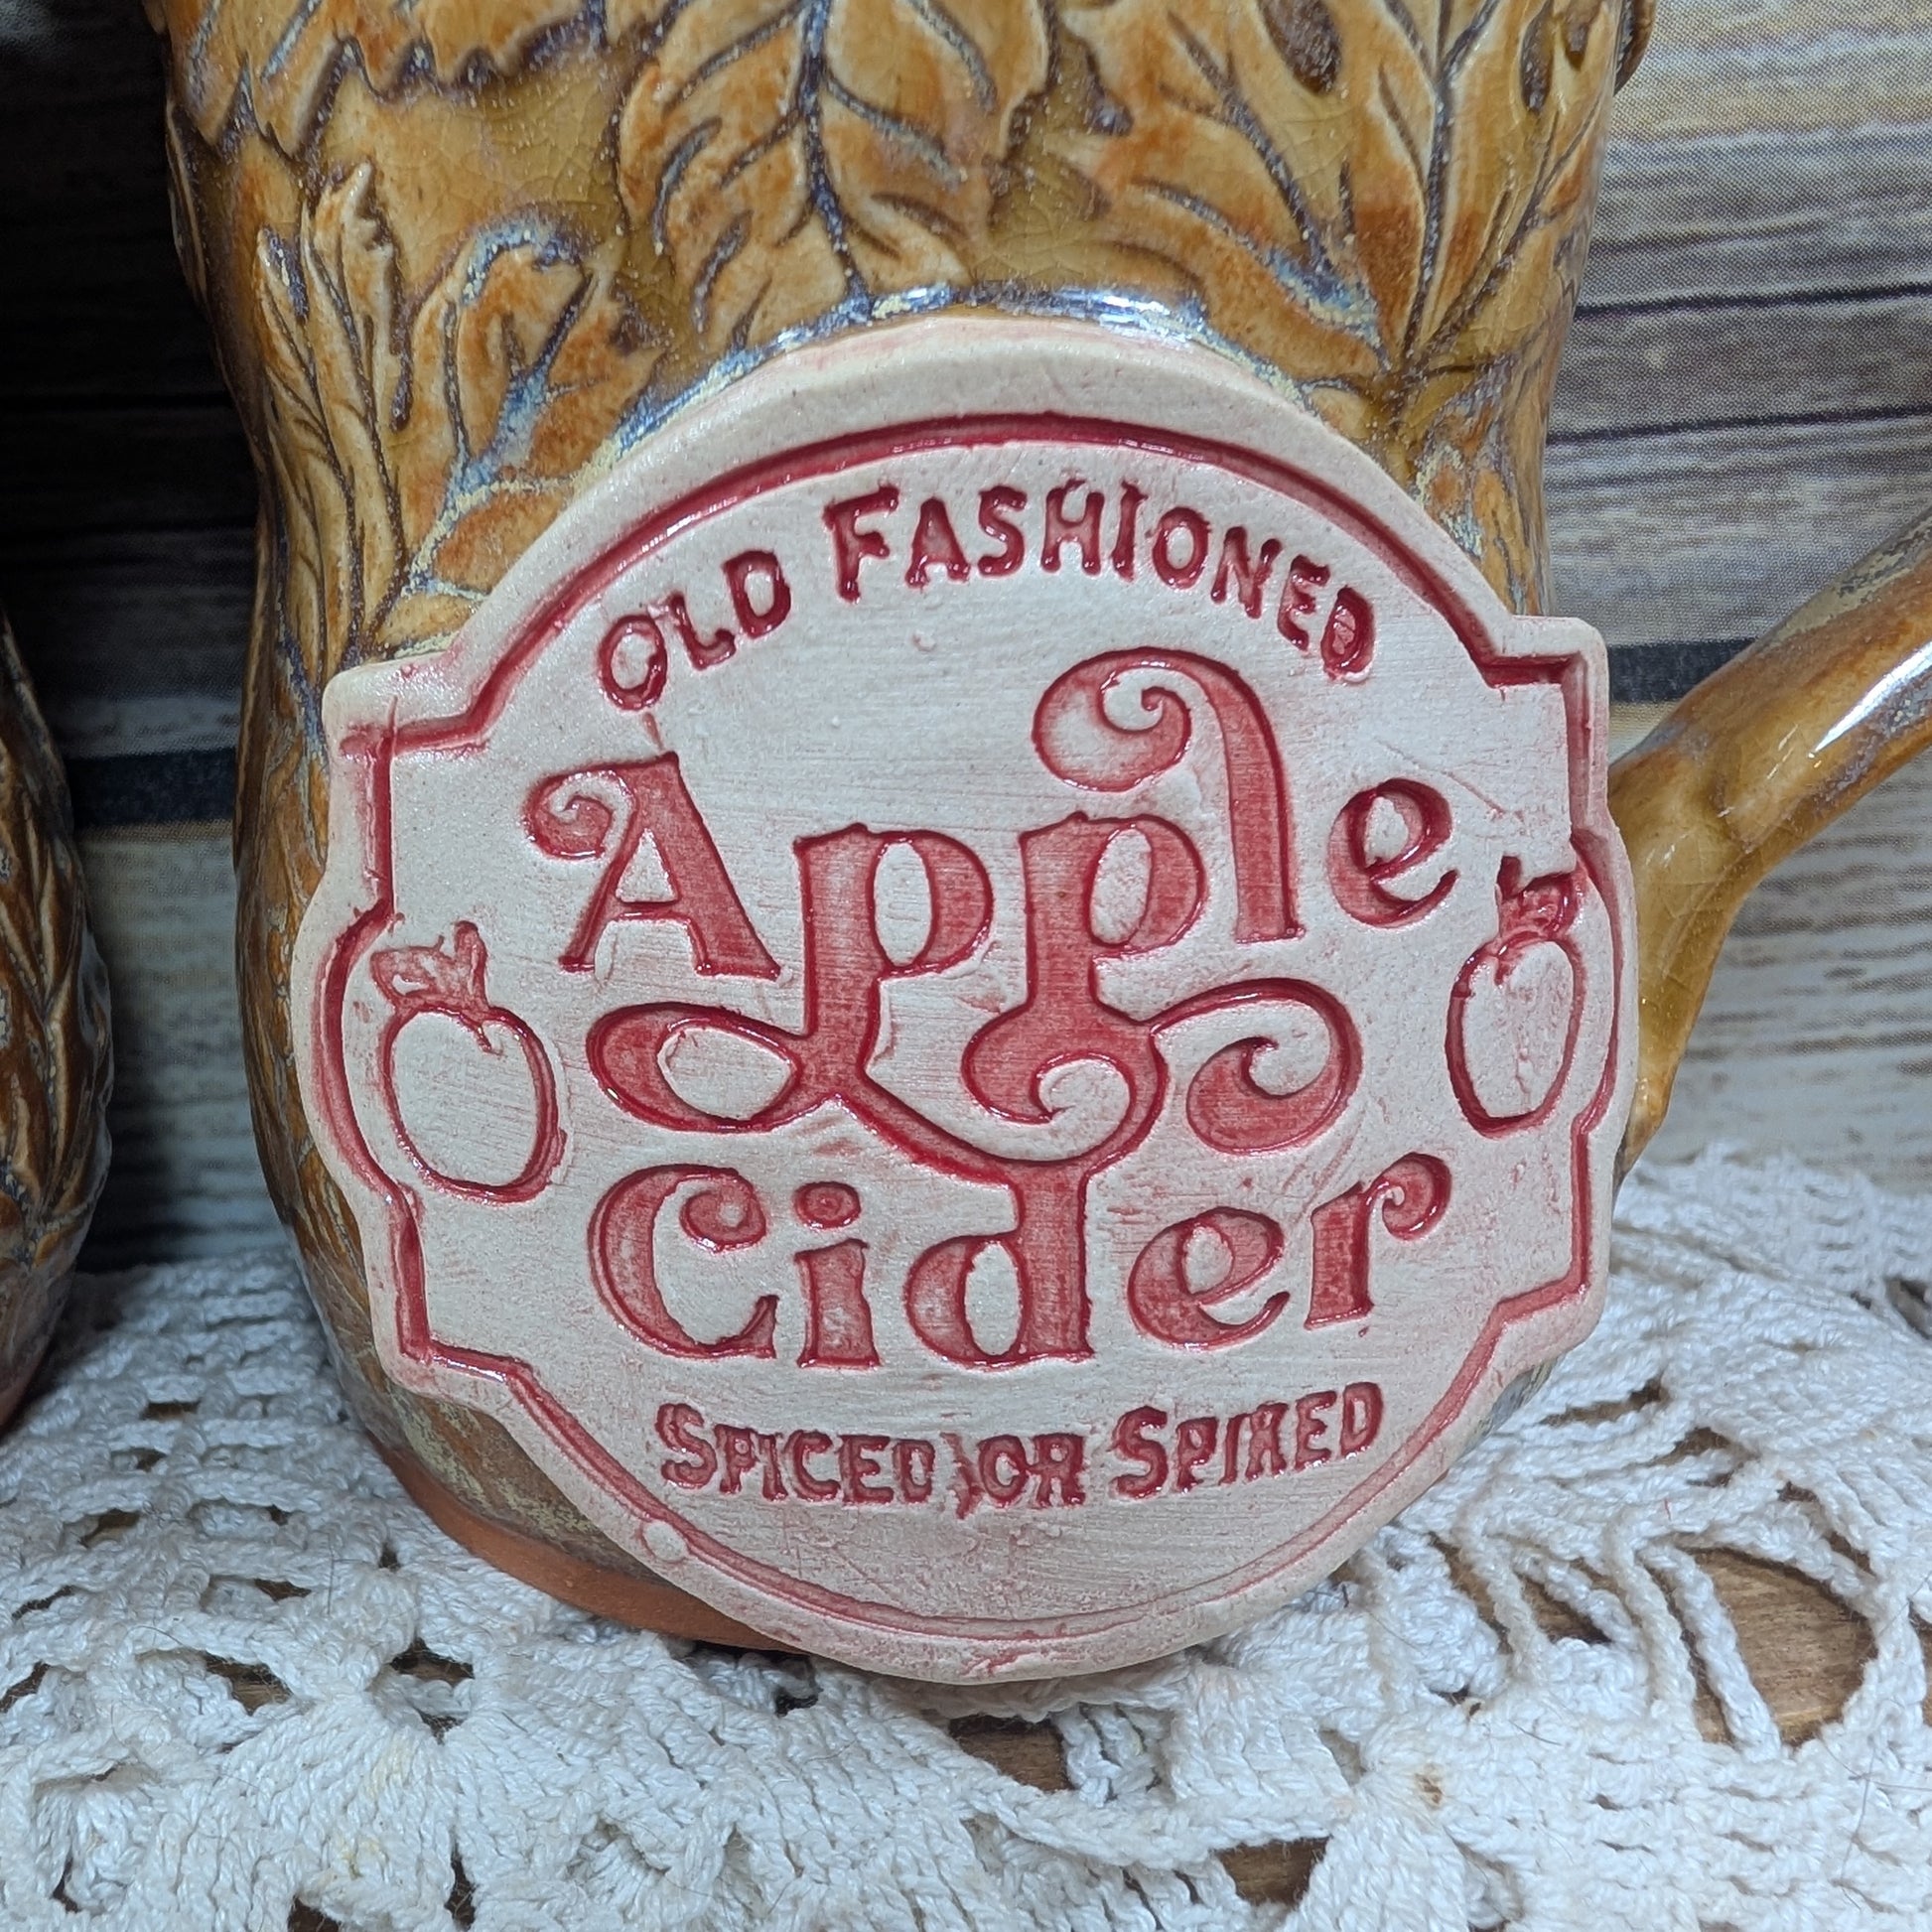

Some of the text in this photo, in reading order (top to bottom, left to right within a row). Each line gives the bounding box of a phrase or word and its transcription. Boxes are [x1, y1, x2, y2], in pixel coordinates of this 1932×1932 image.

[597, 479, 1376, 711] OLD FASHIONED
[522, 645, 1458, 1162] Apple
[587, 1150, 1452, 1370] Cider
[654, 1401, 934, 1505] SPICED
[976, 1432, 1087, 1508] OR
